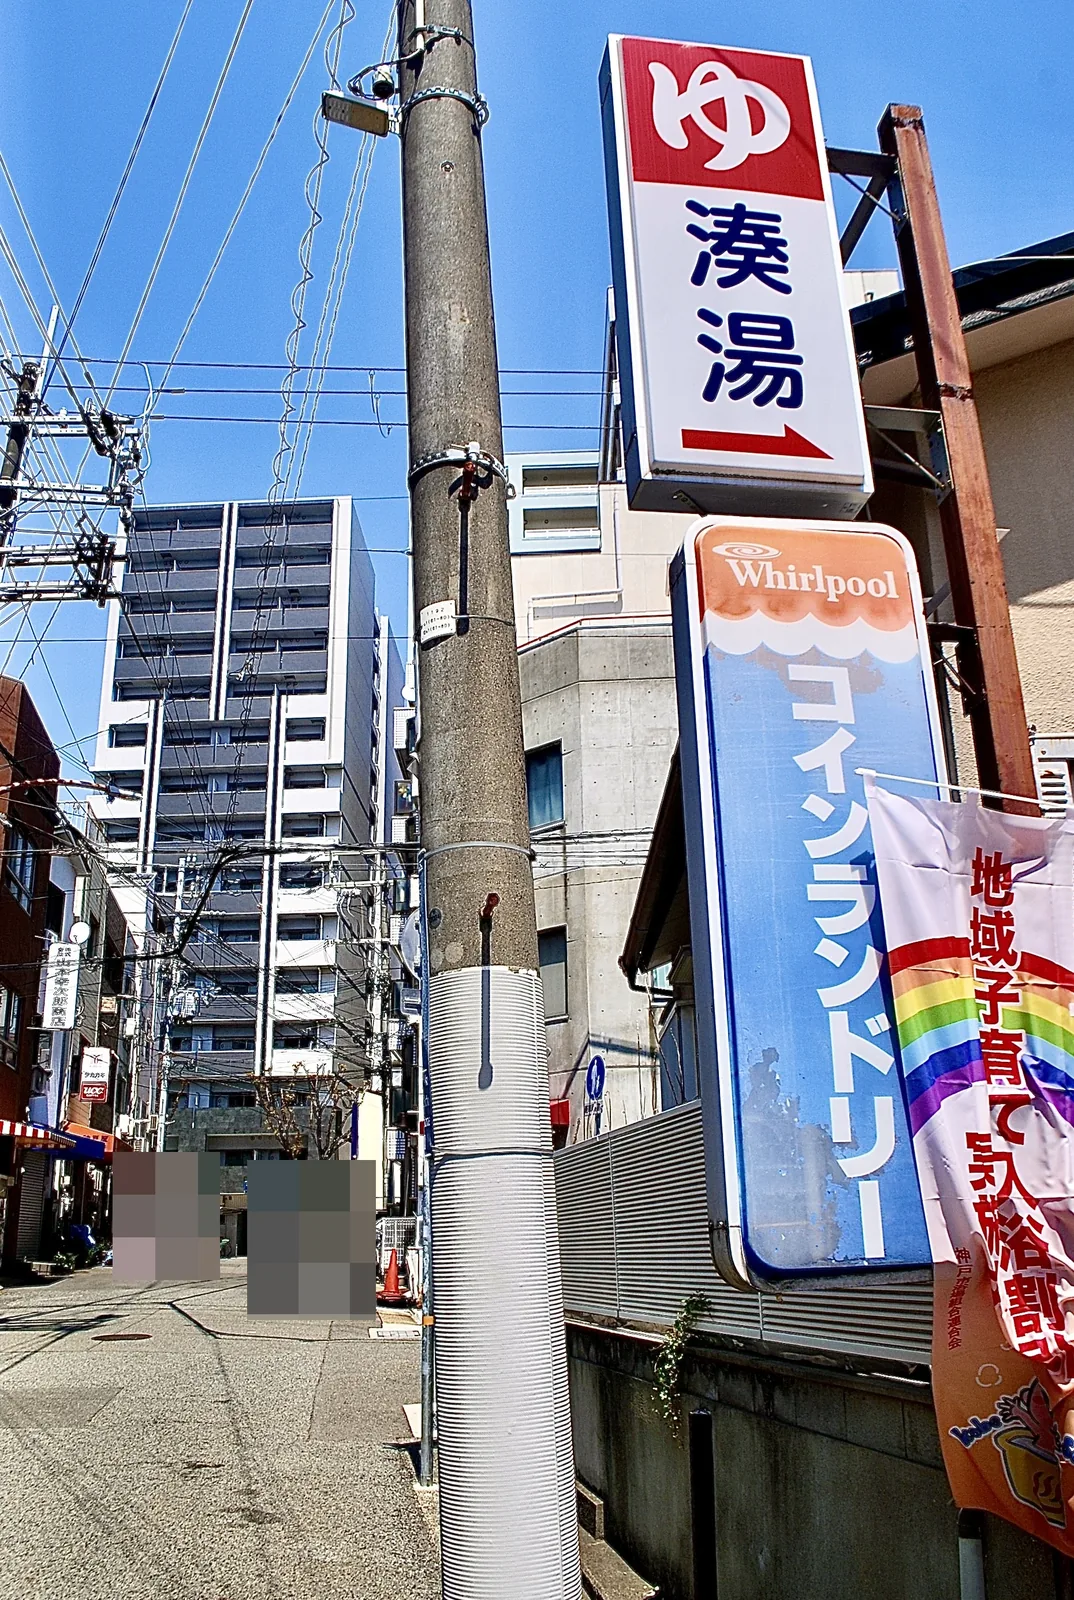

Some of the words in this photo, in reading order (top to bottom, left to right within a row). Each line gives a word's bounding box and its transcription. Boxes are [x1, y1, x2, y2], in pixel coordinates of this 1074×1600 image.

[647, 60, 791, 171] ゆ
[685, 199, 804, 410] 湊湯
[725, 558, 899, 603] Whirlpool
[788, 663, 895, 1259] コインランドリー
[83, 1086, 105, 1095] UCC
